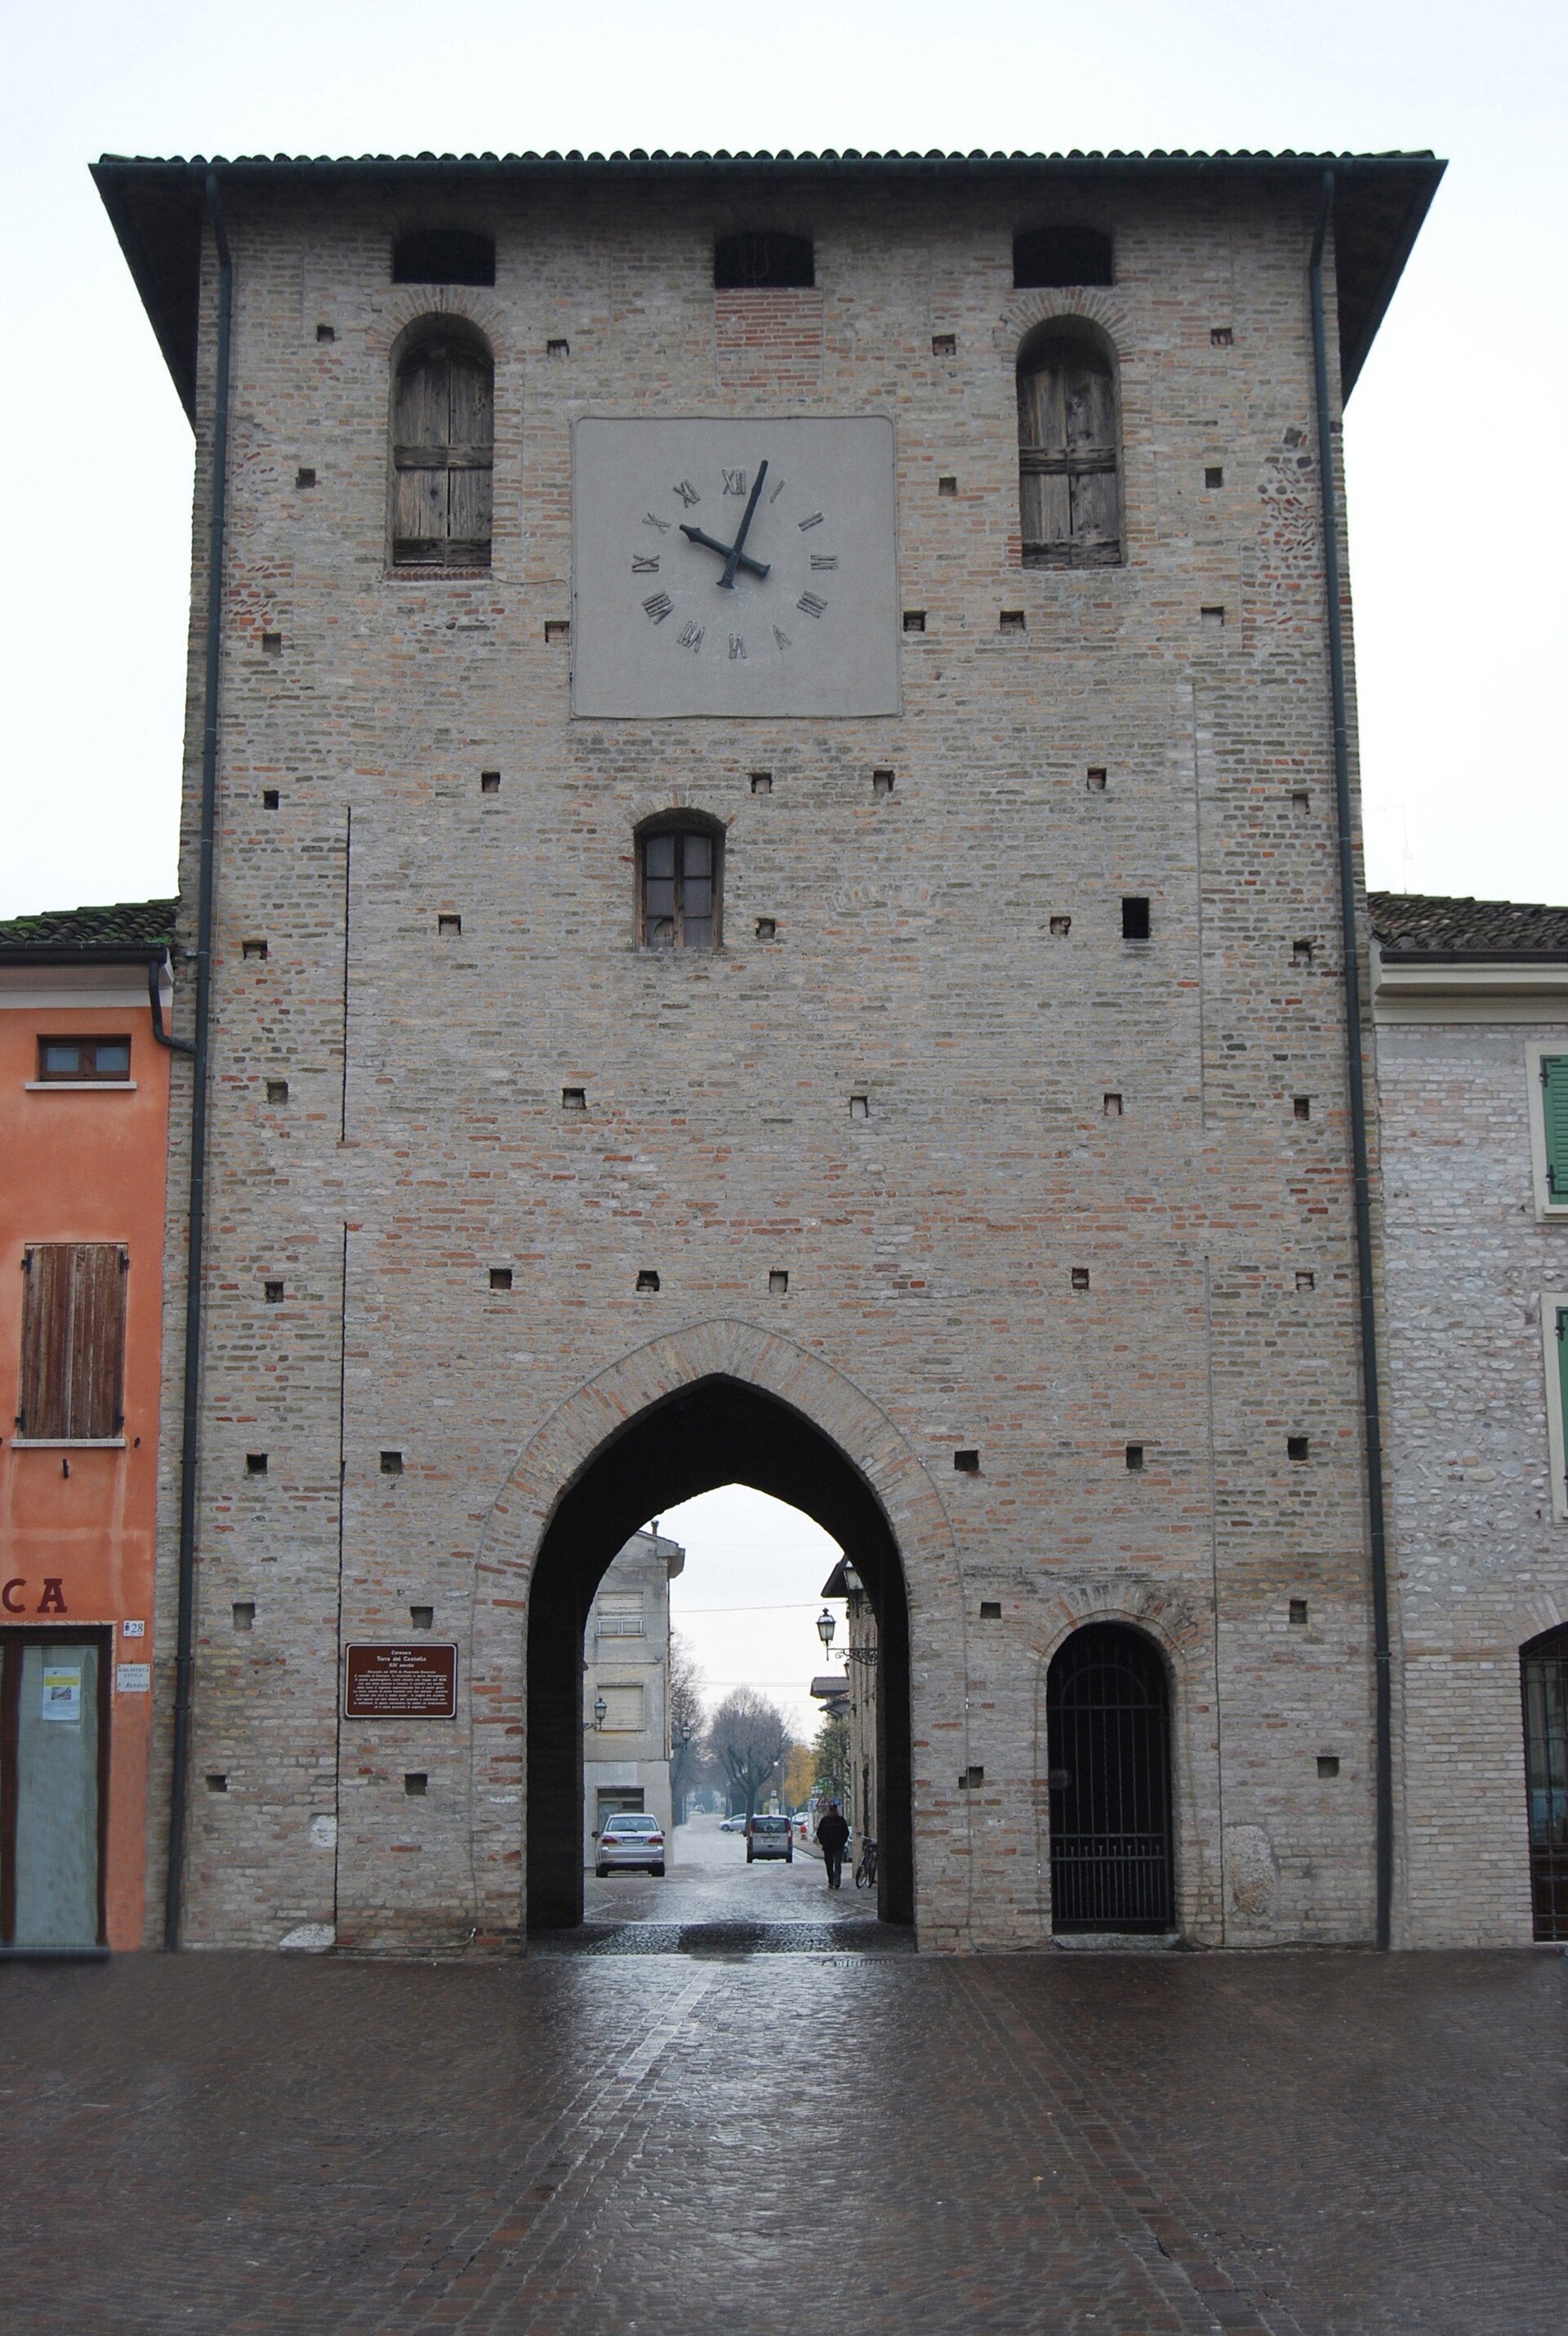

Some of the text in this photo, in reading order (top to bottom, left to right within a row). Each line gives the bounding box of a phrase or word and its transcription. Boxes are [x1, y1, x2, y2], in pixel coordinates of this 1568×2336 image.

[673, 479, 701, 508] XI
[722, 469, 746, 495] XII
[769, 479, 786, 503] I
[642, 512, 671, 534] X
[797, 511, 826, 532] II
[632, 554, 660, 573] IX
[810, 555, 839, 570] III
[642, 591, 675, 625] VIII
[796, 590, 828, 618] IIII
[676, 621, 706, 653] VII
[728, 633, 747, 659] VI
[772, 624, 791, 649] V
[2, 1578, 68, 1613] CA
[131, 1623, 144, 1633] 28
